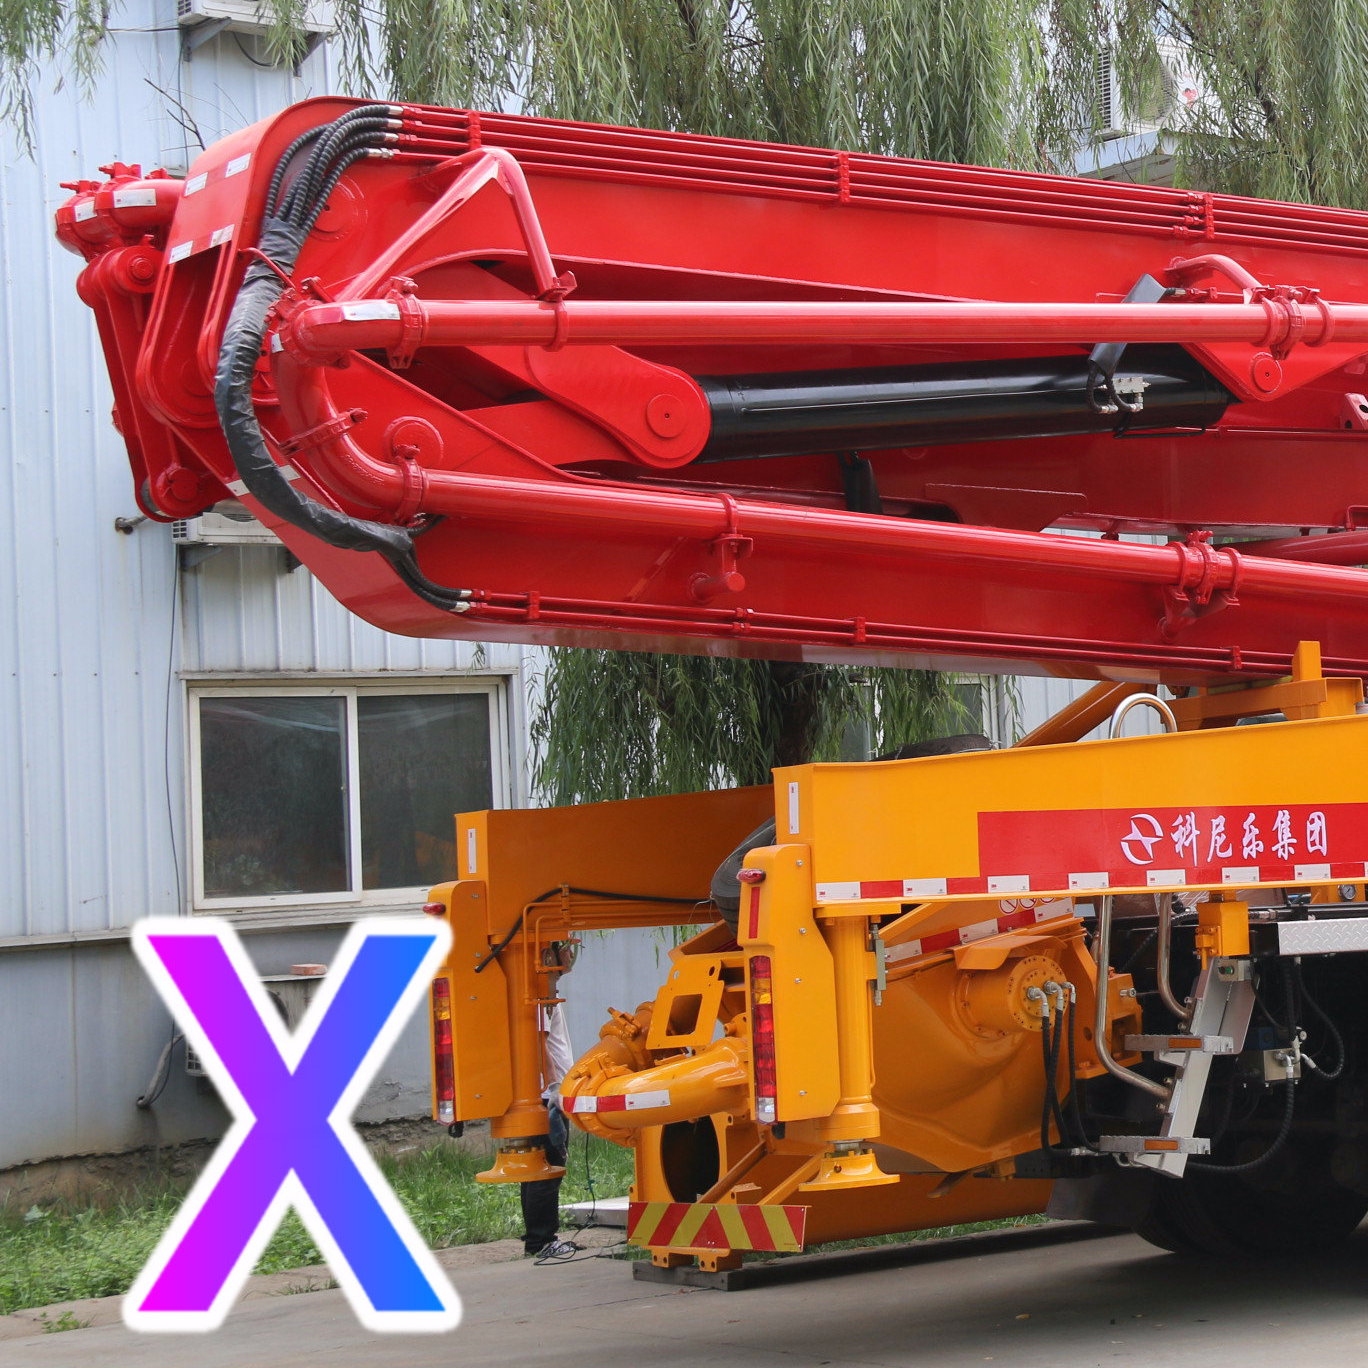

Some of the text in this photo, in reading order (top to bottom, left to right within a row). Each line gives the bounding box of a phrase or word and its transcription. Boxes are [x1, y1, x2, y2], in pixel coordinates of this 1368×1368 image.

[1170, 809, 1328, 867] 科尼乐集团
